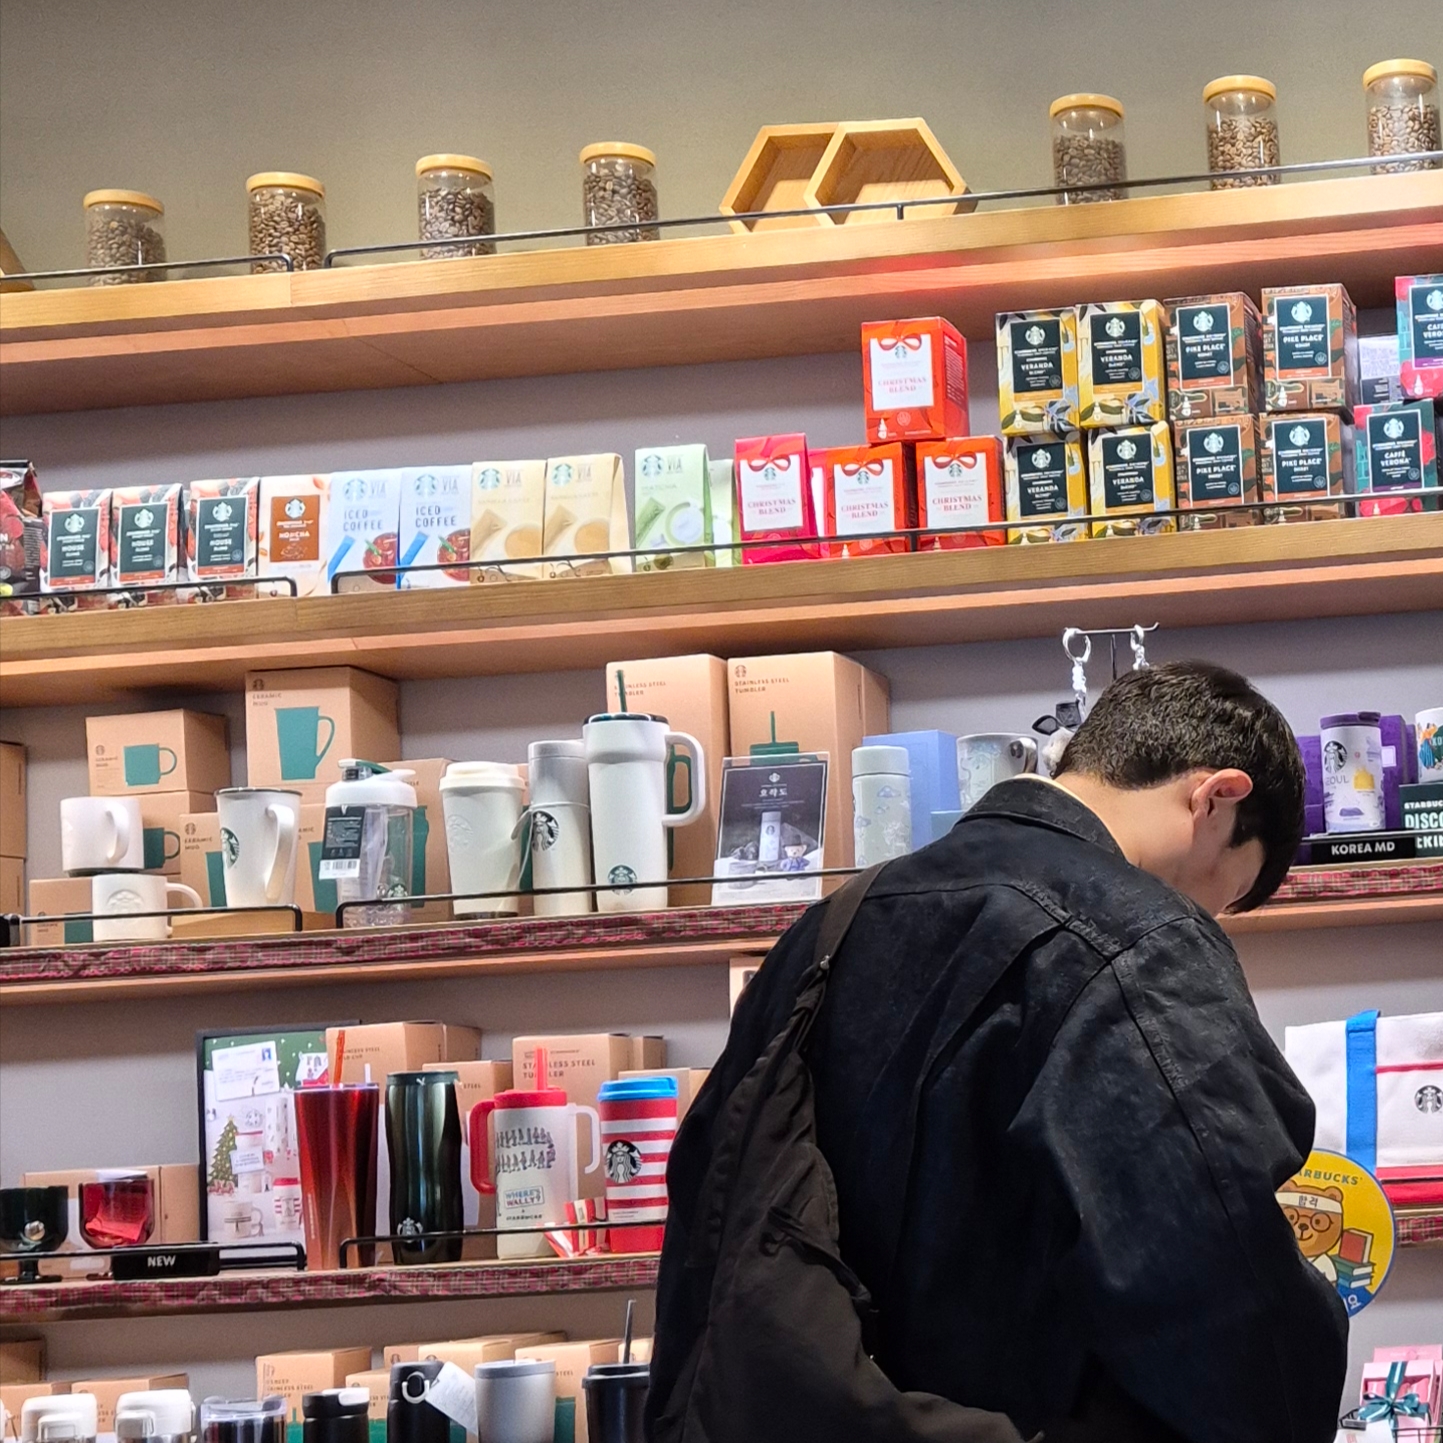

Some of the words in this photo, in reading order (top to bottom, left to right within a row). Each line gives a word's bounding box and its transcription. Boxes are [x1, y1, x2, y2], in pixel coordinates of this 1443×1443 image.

[748, 498, 796, 508] CHRISTMAS
[932, 494, 982, 505] CHRISTMAS
[416, 505, 440, 516] ICED
[759, 507, 786, 515] BLEND
[841, 502, 888, 512] CHRISTMAS
[943, 503, 972, 512] BLEND
[344, 510, 368, 519] ICED
[851, 510, 878, 519] BLEND
[343, 520, 382, 531] COFFEE
[416, 516, 457, 527] COFFEE
[1325, 775, 1349, 786] EOUL
[1331, 843, 1372, 856] KOREA
[1374, 841, 1396, 852] MD
[523, 1061, 568, 1069] STALESS
[523, 1071, 564, 1079] TULER
[1298, 1168, 1360, 1186] RBUCKS
[506, 1193, 541, 1207] WALLY?
[1298, 1194, 1319, 1208] 합격
[147, 1255, 176, 1267] NEW
